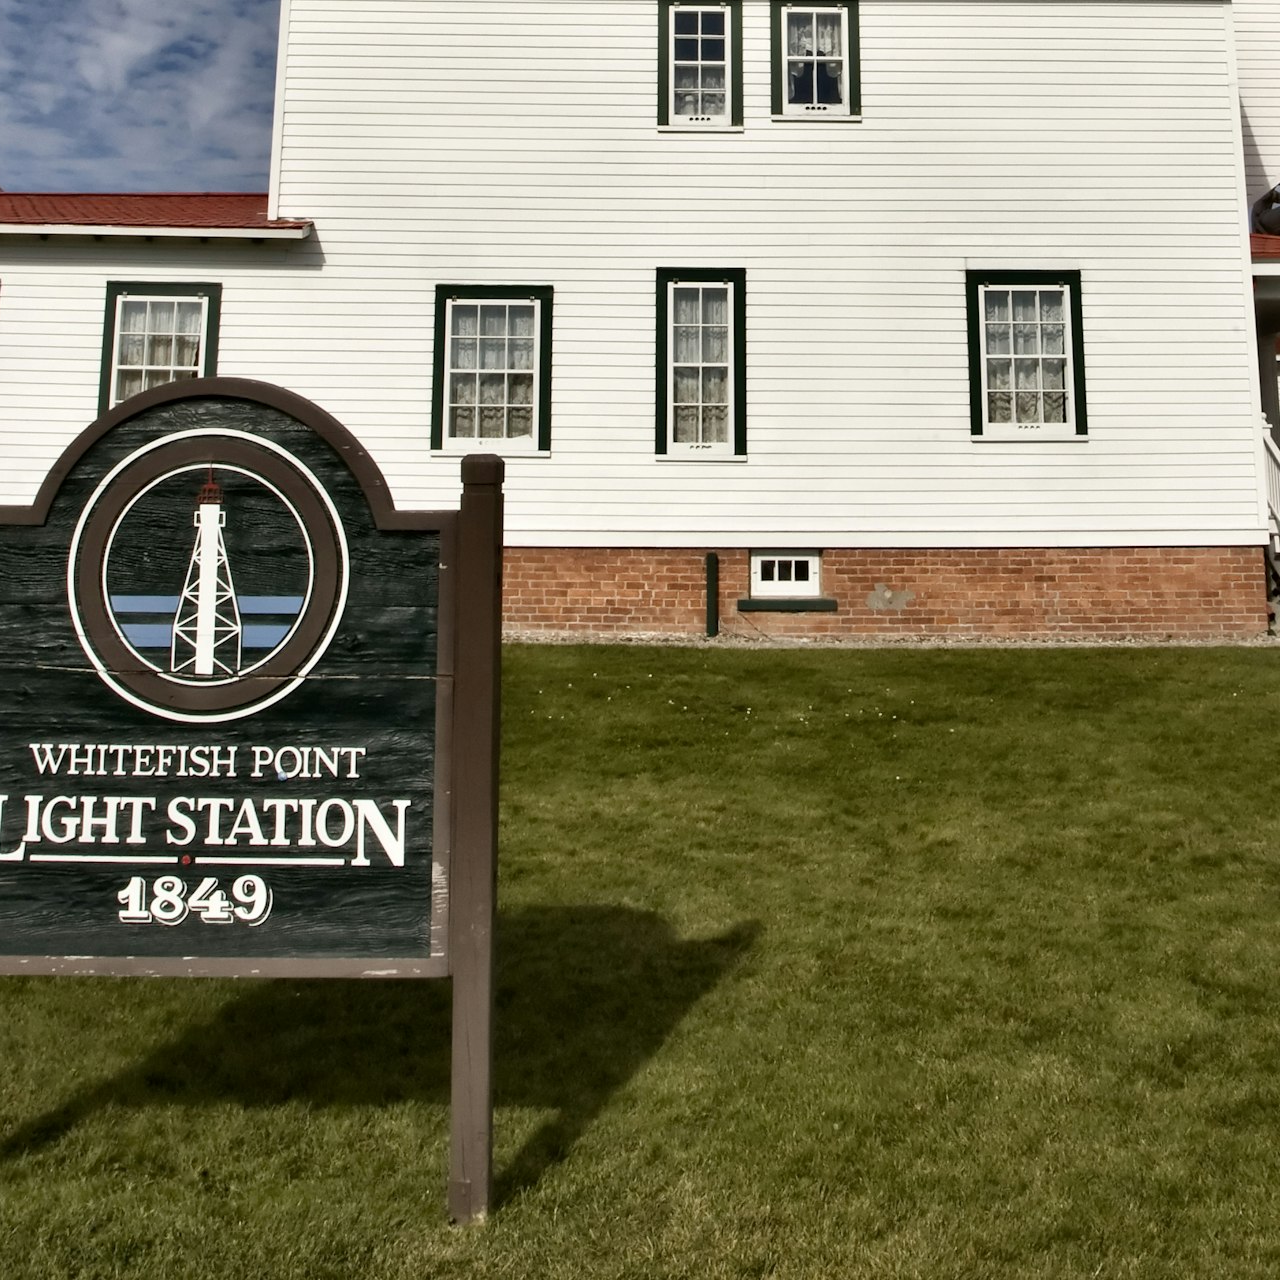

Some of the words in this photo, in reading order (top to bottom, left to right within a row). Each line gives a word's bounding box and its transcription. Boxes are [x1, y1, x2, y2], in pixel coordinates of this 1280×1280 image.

[29, 744, 236, 777] WHITEFISH
[251, 746, 366, 778] POINT
[166, 797, 411, 867] STATION
[118, 875, 273, 926] 1849
